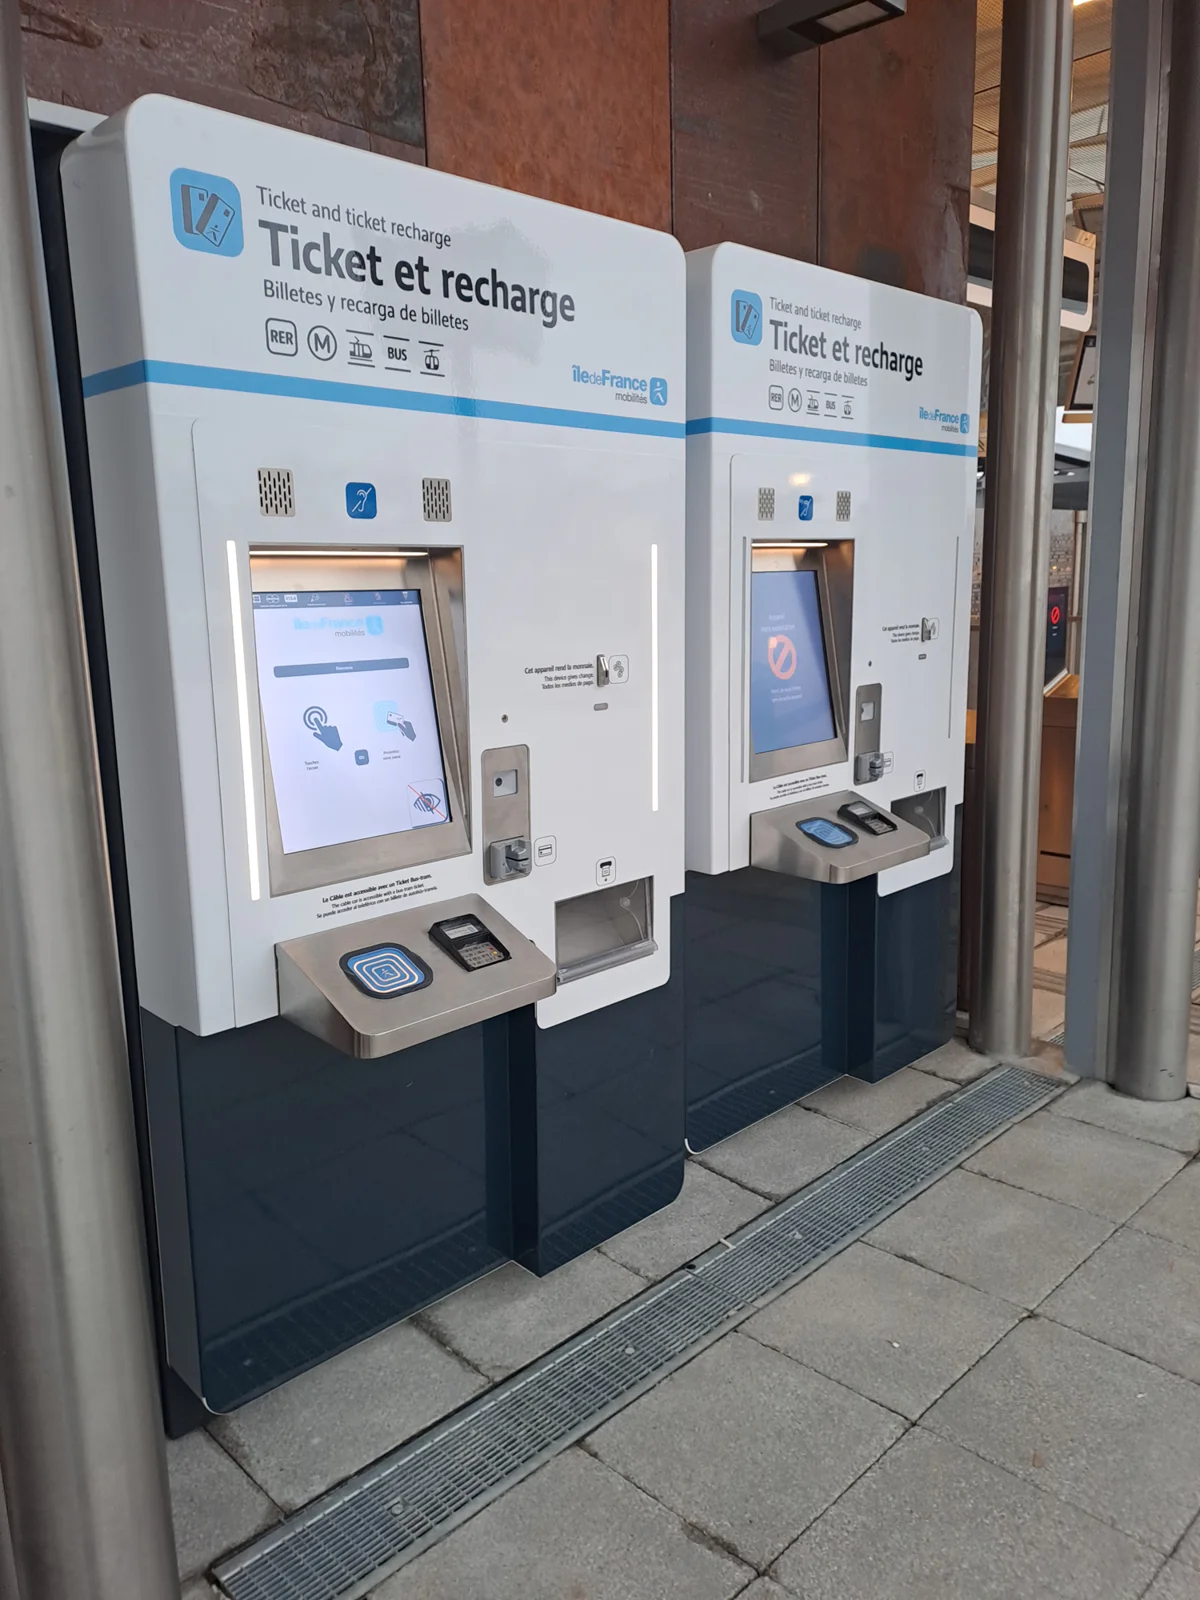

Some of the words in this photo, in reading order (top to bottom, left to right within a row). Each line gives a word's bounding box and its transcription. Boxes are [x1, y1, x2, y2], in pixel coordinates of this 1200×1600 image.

[256, 185, 307, 215] Ticket
[312, 203, 341, 222] and
[345, 208, 386, 233] ticket
[391, 221, 451, 249] recharge
[258, 219, 384, 286] Ticket
[394, 256, 431, 295] et
[441, 267, 575, 328] recharge
[263, 278, 323, 306] Billetes
[327, 295, 336, 313] y
[340, 297, 395, 322] recarga
[400, 304, 417, 322] de
[421, 306, 469, 331] billetes
[769, 296, 793, 314] Ticket
[794, 305, 809, 317] and
[810, 306, 830, 323] ticket
[831, 313, 862, 331] recharge
[270, 328, 294, 346] RER
[313, 332, 331, 354] M
[387, 346, 407, 362] BUS
[769, 318, 827, 359] Ticket
[832, 336, 850, 364] et
[855, 341, 923, 382] recharge
[769, 358, 797, 375] Billetes
[798, 367, 804, 379] y
[805, 367, 832, 383] recarga
[833, 370, 842, 383] de
[843, 371, 868, 387] billetes
[615, 392, 648, 404] mobilités
[771, 392, 782, 403] RER
[825, 400, 836, 410] BUS
[534, 664, 554, 674] appareil
[329, 893, 343, 901] Câble
[353, 885, 377, 896] accessible
